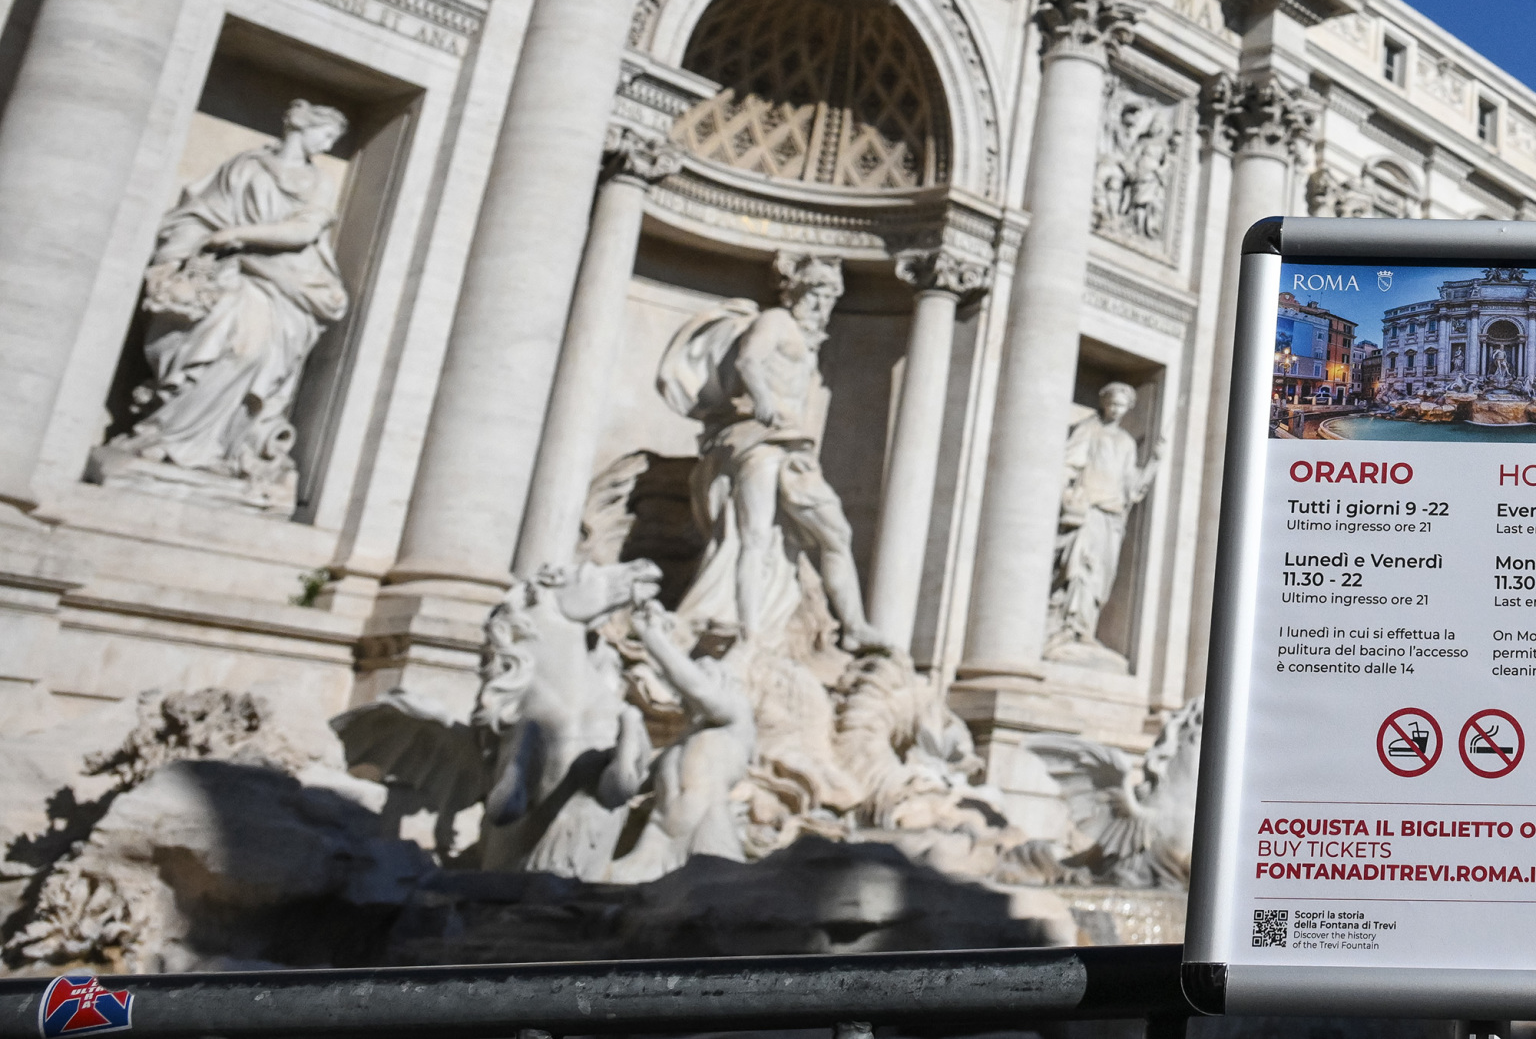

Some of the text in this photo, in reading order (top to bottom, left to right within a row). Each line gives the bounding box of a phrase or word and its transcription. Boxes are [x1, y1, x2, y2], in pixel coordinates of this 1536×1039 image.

[1293, 274, 1360, 291] ROMA
[1290, 460, 1413, 484] ORARIO
[1288, 499, 1330, 514] Tutti
[1337, 499, 1341, 514] i
[1346, 500, 1400, 518] giorni
[1405, 502, 1416, 515] 9
[1287, 519, 1431, 533] Ultimo ingresso ore 21
[1497, 523, 1523, 534] Last
[1285, 552, 1442, 569] Lunedì e Venerdì
[1283, 572, 1324, 586] 11.30
[1341, 573, 1362, 587] 22
[1494, 575, 1535, 590] 11.30
[1282, 592, 1428, 606] Ultimo ingresso ore 21
[1495, 596, 1521, 607] Last
[1280, 626, 1455, 640] I lunedì in cui si effettua la
[1493, 630, 1512, 641] On
[1278, 643, 1468, 658] pulitura del bacino l'accesso
[1277, 661, 1414, 674] è consentito dalle 14
[1258, 818, 1369, 838] ACQUISTA
[1376, 820, 1394, 836] IL
[1401, 820, 1513, 838] BIGLIETTO
[1258, 840, 1391, 858] BUY TICKETS
[1295, 910, 1364, 920] Scopri la storia
[1294, 920, 1396, 930] della Fontana di Trevi
[1294, 931, 1329, 939] Discover
[1348, 932, 1376, 941] history
[1293, 940, 1379, 949] of the Trevi Fountain
